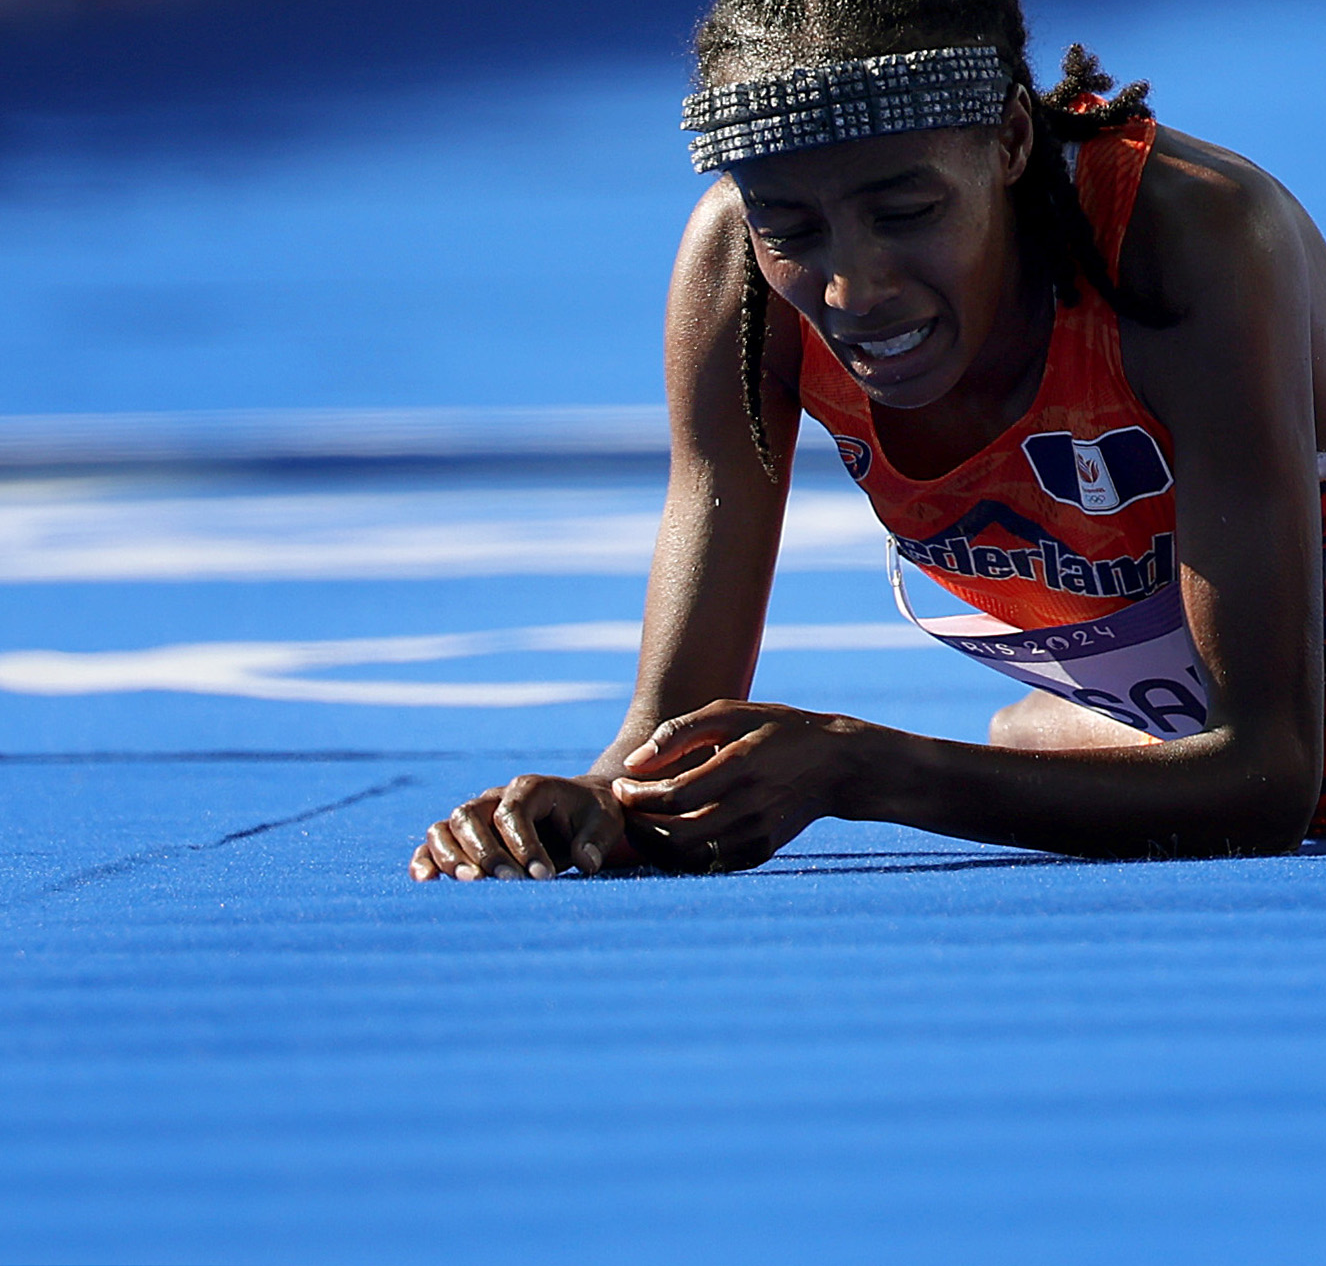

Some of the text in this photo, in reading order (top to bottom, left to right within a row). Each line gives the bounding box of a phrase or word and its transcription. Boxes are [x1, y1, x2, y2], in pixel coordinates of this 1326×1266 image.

[897, 532, 1175, 597] ederland
[1024, 625, 1116, 655] 2024
[1022, 665, 1207, 733] SA
